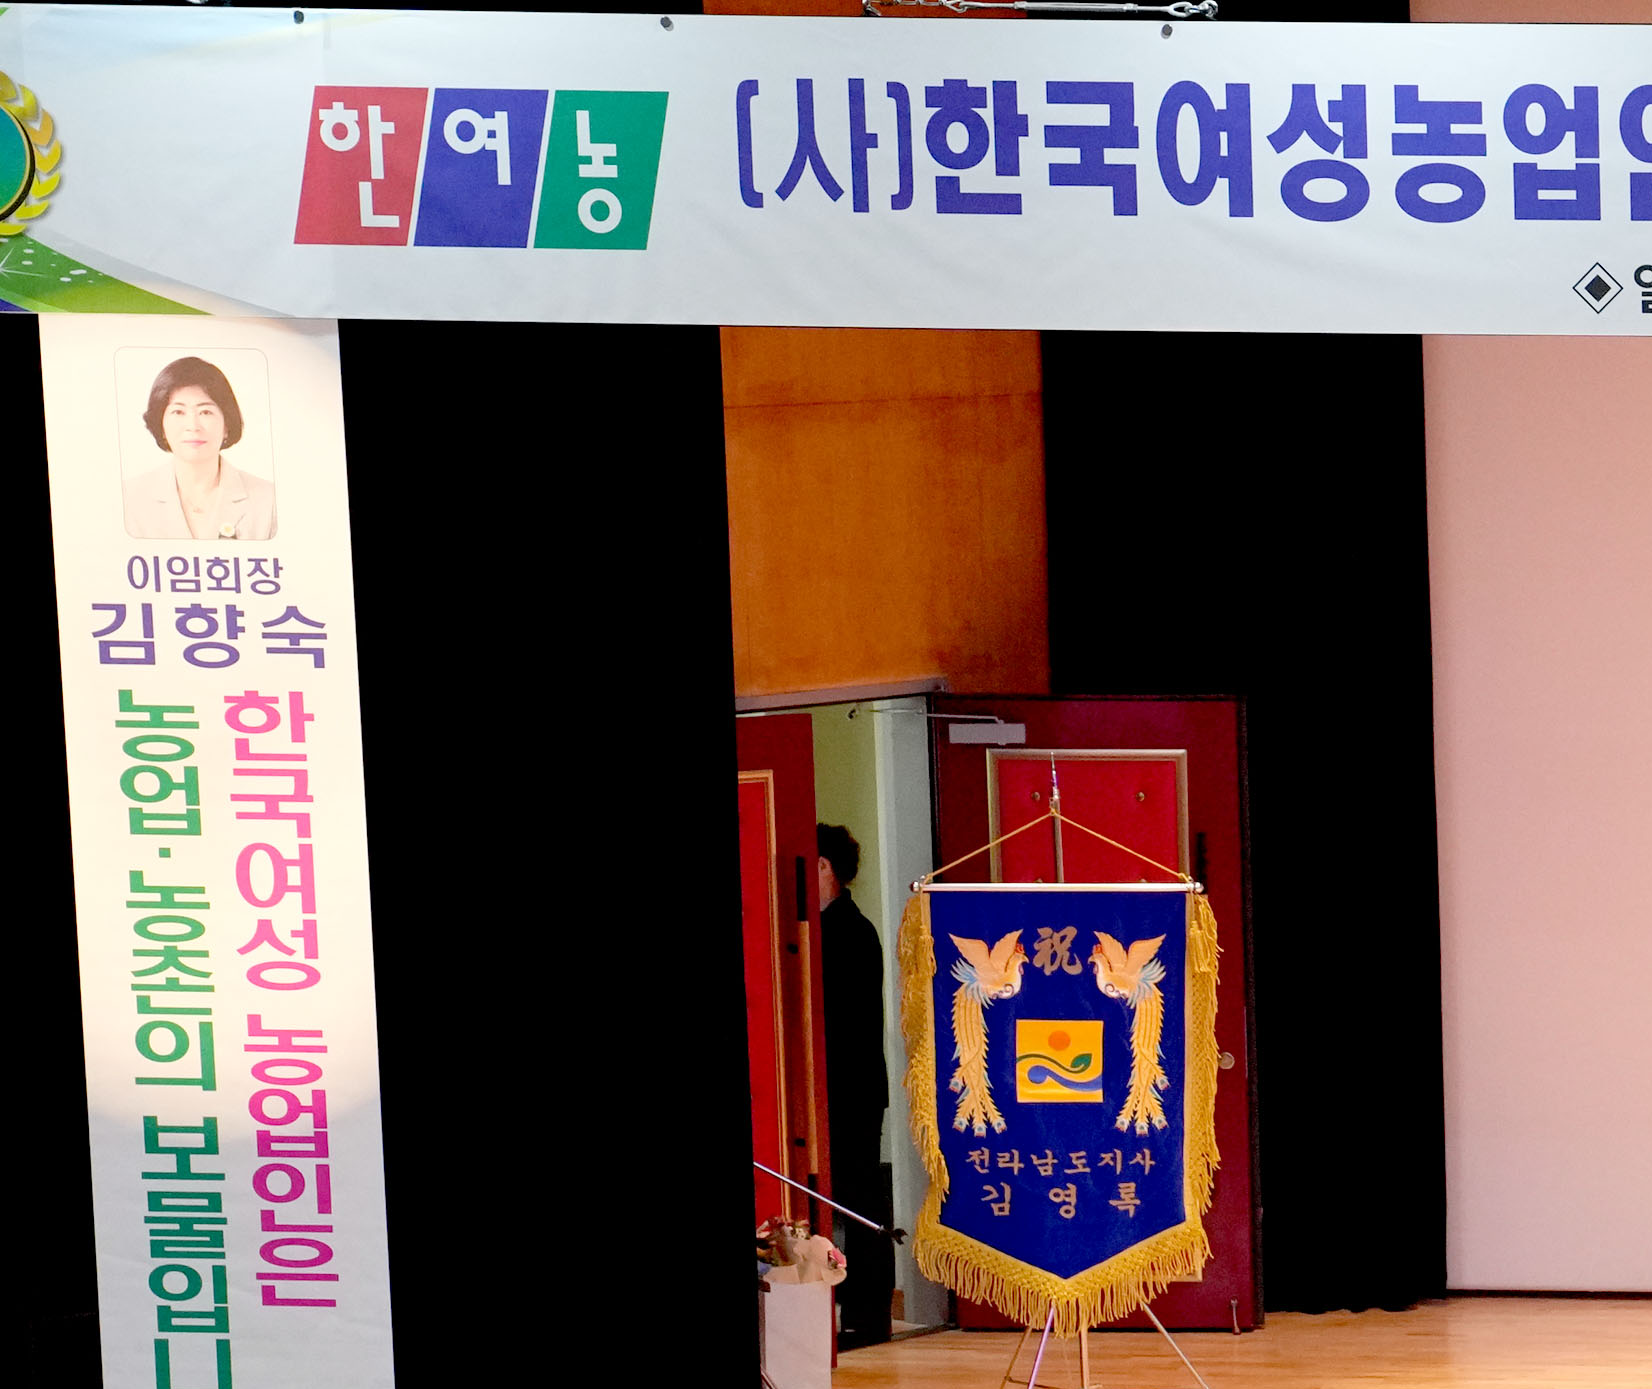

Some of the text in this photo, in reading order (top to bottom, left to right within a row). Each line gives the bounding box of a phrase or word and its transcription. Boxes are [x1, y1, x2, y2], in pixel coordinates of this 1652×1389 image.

[318, 103, 624, 237] 한여농
[127, 554, 284, 595] 이임회장
[91, 602, 328, 669] 김향숙
[115, 689, 217, 1092] 농업·농촌의
[1033, 925, 1084, 976] 祝
[223, 690, 340, 1308] 한국여성 농업인은
[965, 1148, 1156, 1177] 전라남도지사
[981, 1181, 1141, 1219] 김영록
